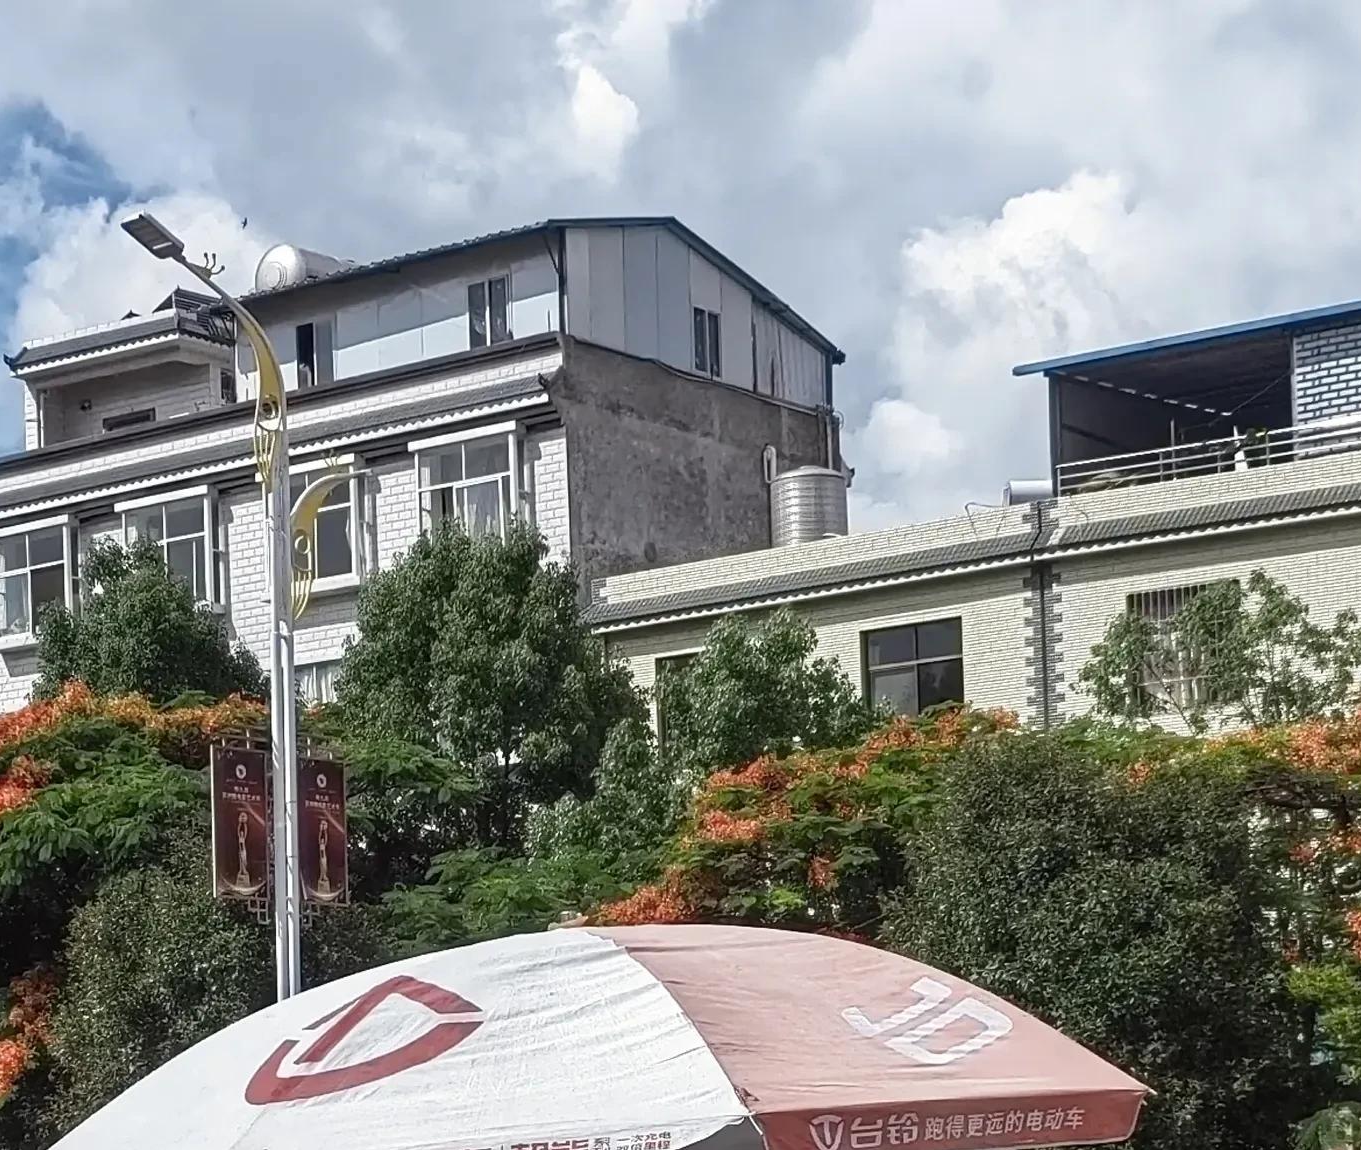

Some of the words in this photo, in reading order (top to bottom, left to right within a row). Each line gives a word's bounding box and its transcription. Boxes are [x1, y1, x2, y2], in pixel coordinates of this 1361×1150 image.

[850, 1112, 920, 1150] 台铃
[924, 1105, 1086, 1142] 跑得更远的电动车
